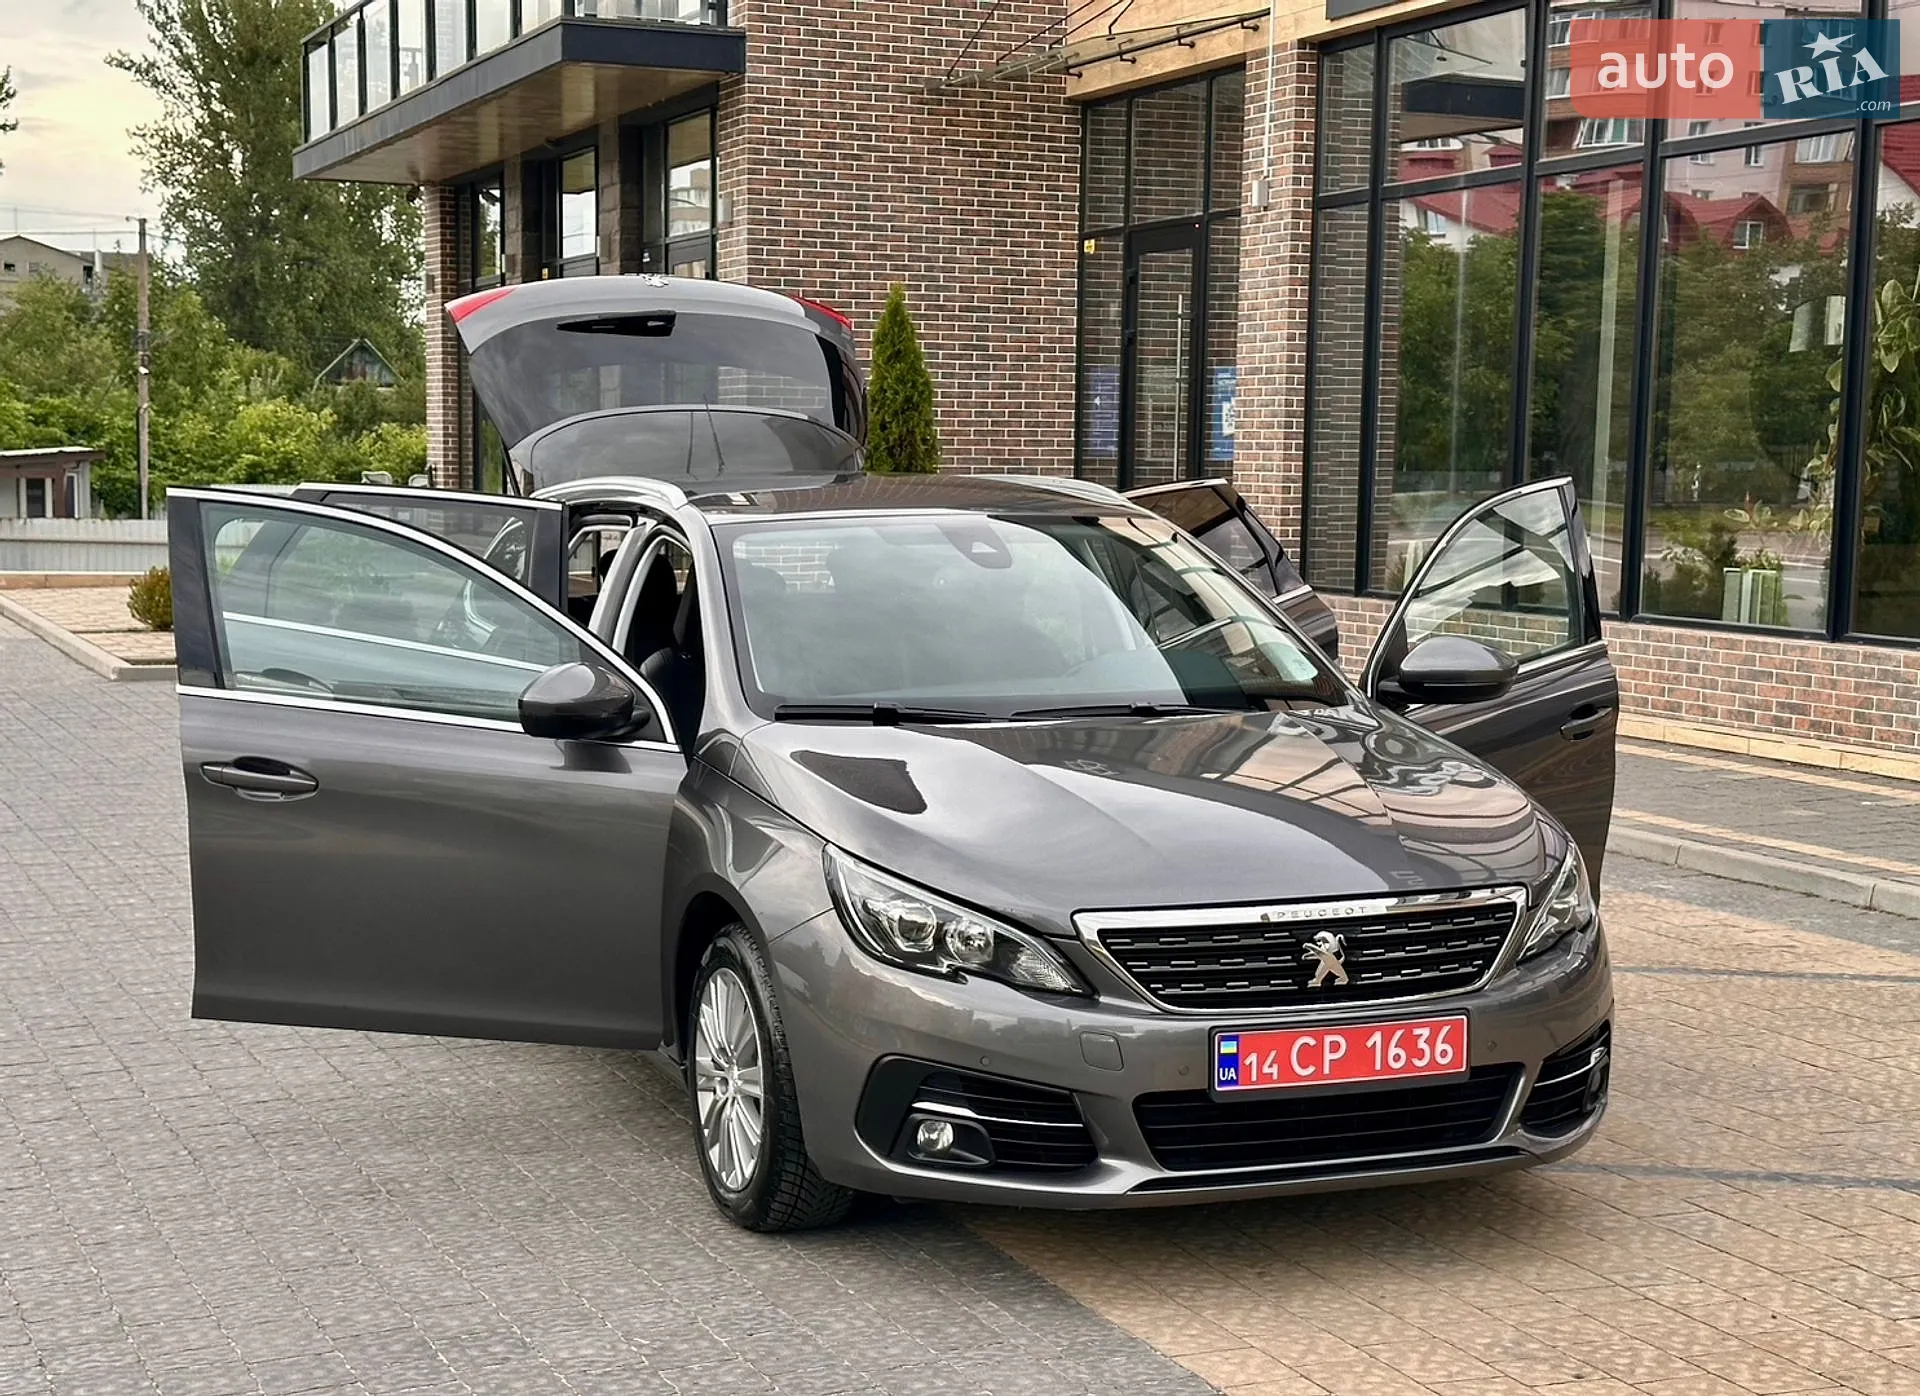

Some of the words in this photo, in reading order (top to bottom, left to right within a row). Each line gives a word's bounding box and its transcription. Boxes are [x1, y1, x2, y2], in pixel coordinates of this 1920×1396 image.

[1277, 906, 1368, 918] PEUGEOT
[1243, 1050, 1279, 1082] 14
[1290, 1034, 1347, 1077] CP
[1365, 1025, 1454, 1071] 1636
[1219, 1067, 1237, 1081] UA
